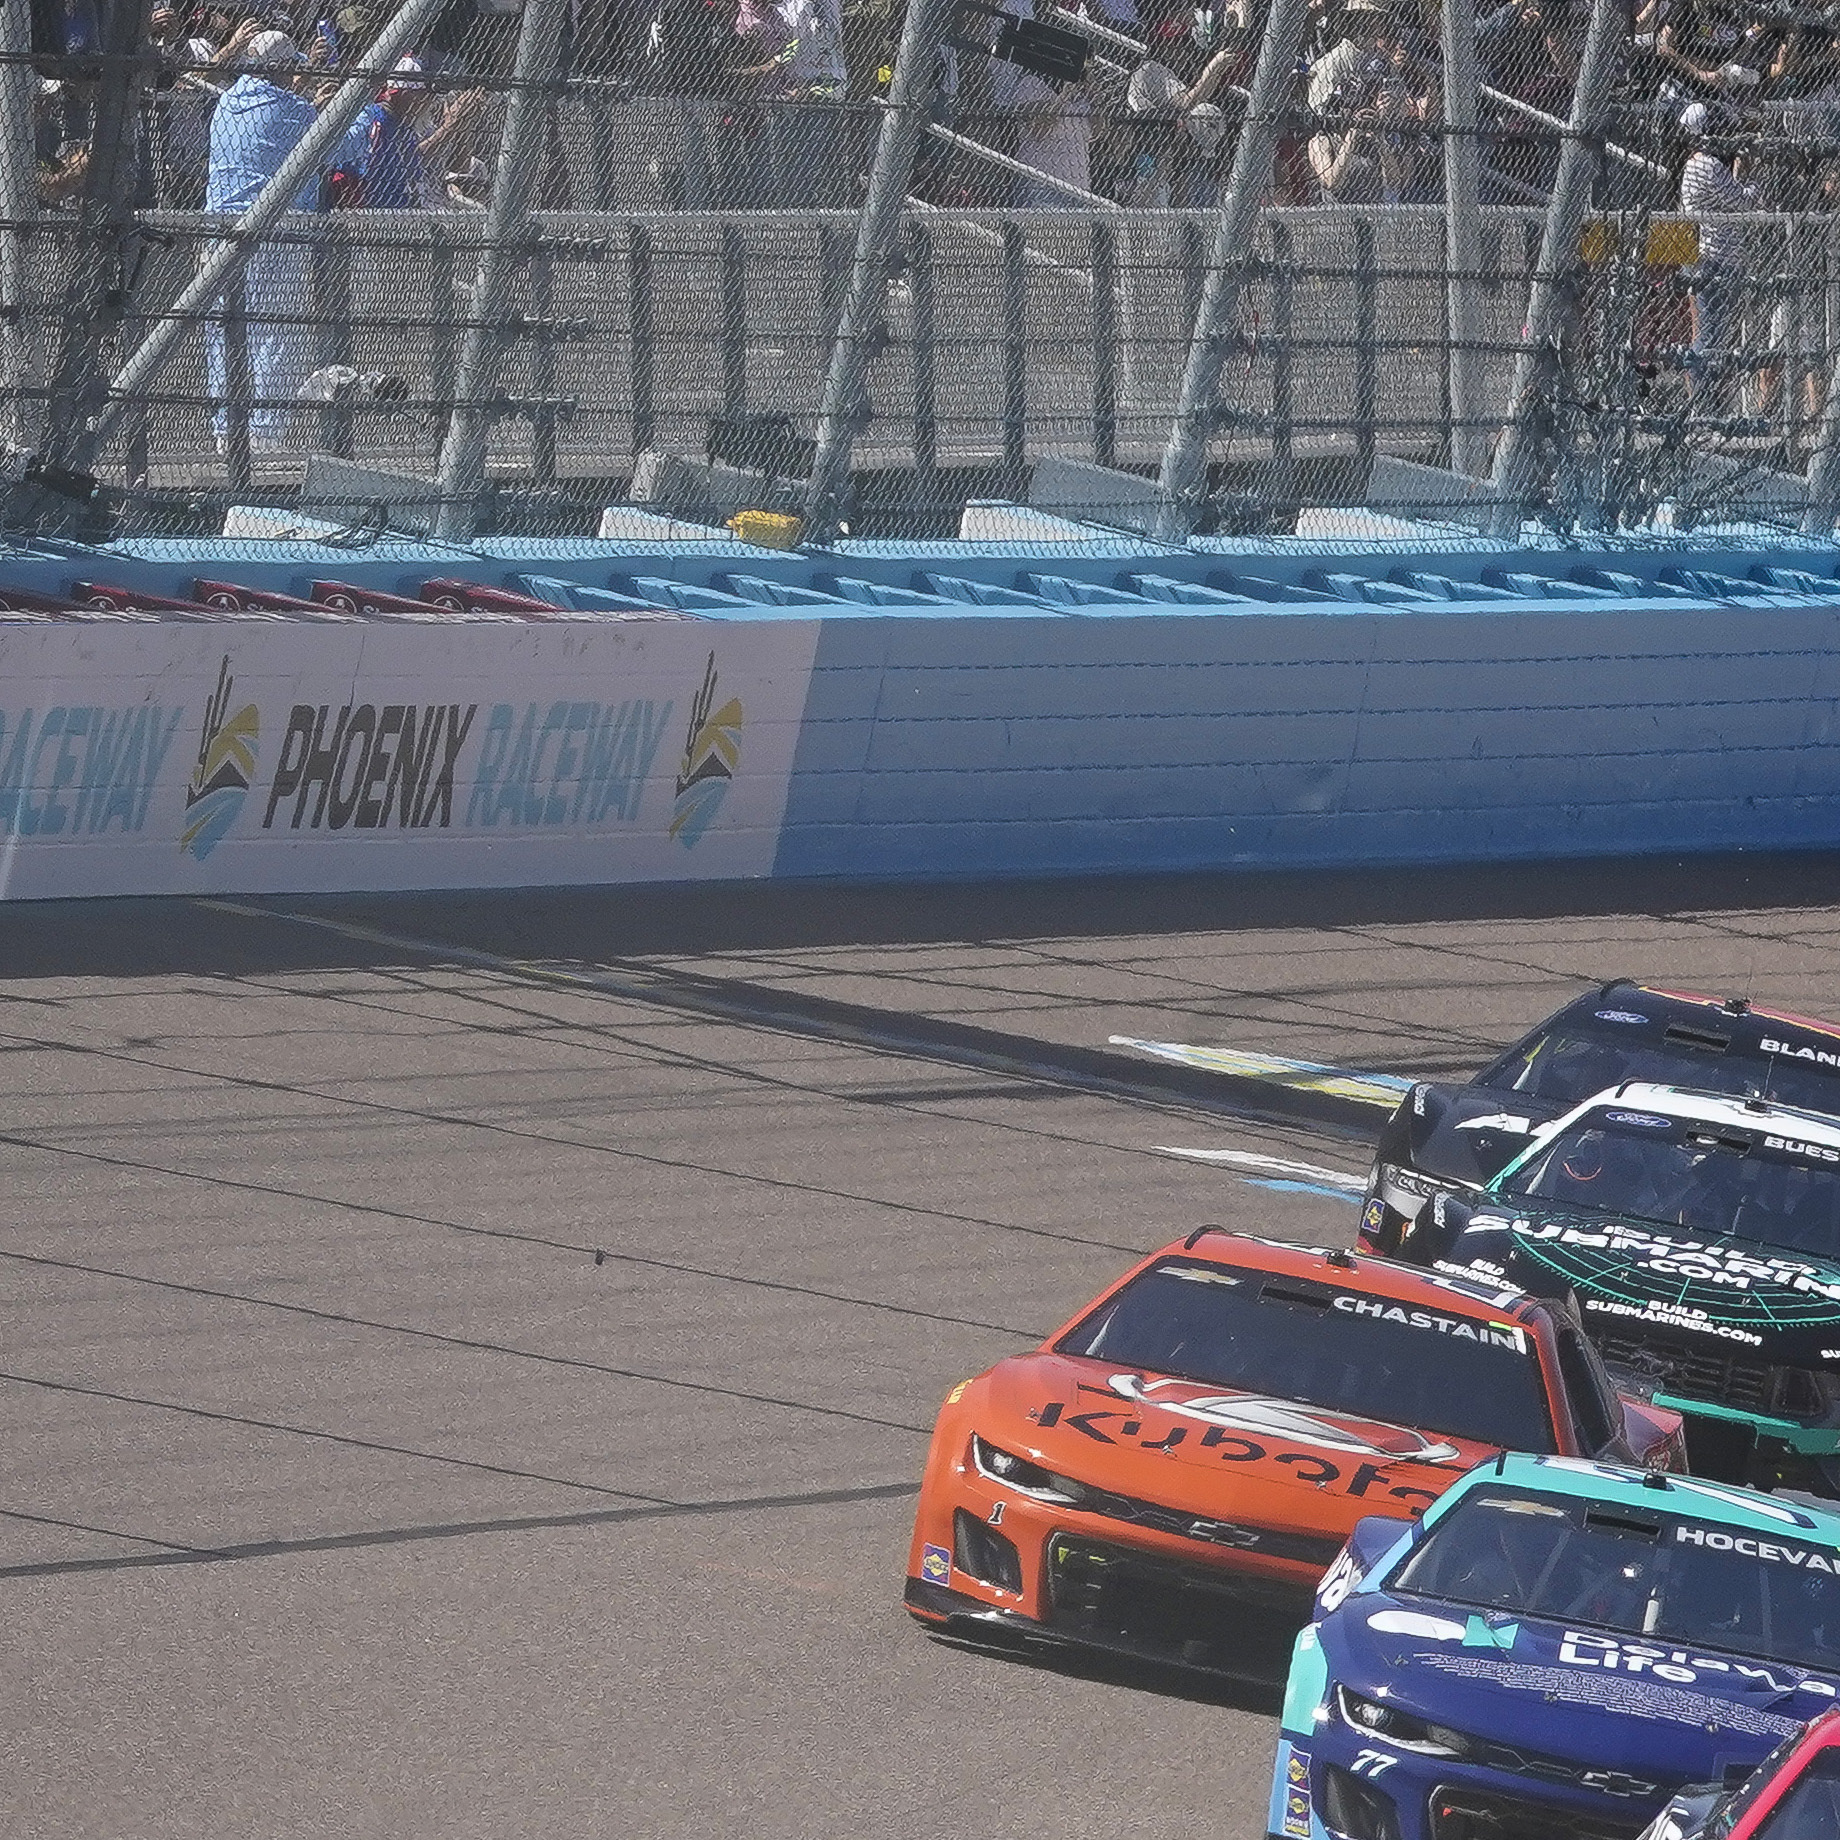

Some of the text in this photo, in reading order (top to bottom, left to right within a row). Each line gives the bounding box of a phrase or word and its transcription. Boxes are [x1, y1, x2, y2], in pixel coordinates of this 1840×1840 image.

[262, 700, 673, 830] PHOENIX RACEWAY
[1333, 1297, 1524, 1349] CHASTAIN
[1586, 1300, 1762, 1346] SUBMARINES.COM
[1648, 1300, 1710, 1321] BUILD
[1559, 1642, 1697, 1683] Life
[1351, 1749, 1398, 1777] 77
